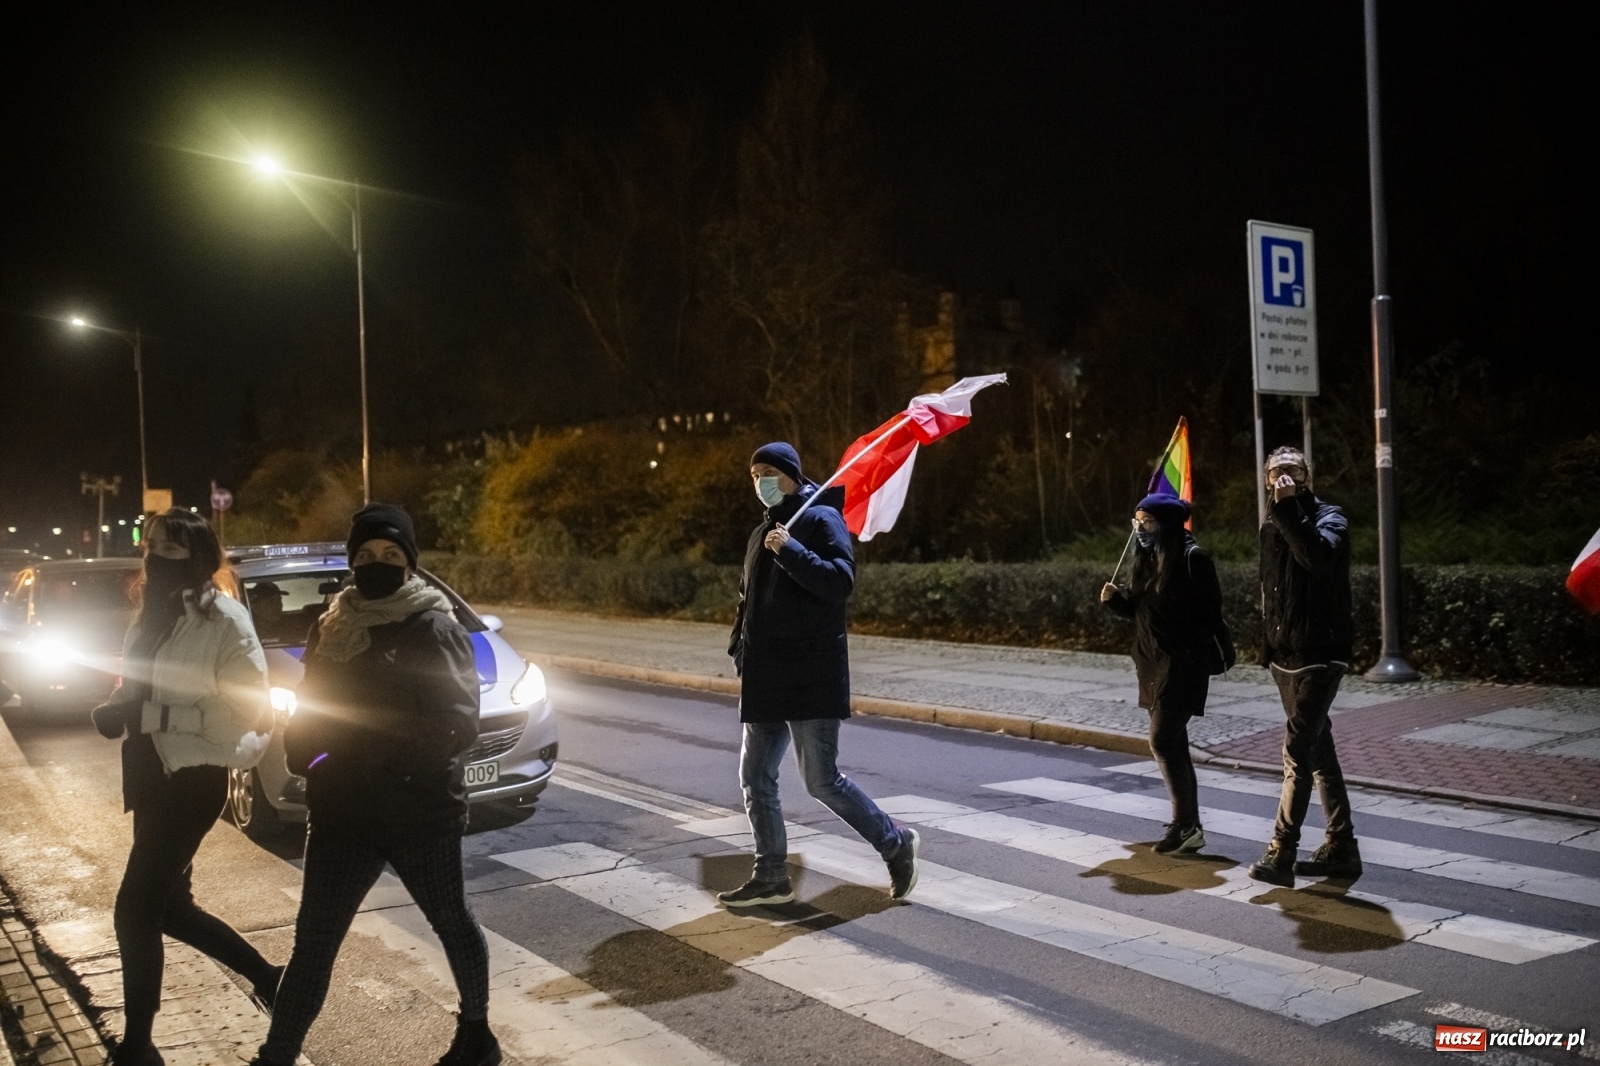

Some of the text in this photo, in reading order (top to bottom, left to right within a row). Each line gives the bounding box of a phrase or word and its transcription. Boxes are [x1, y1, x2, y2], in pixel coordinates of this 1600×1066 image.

[1271, 245, 1296, 297] P
[268, 546, 306, 555] POLICJA
[467, 765, 495, 783] 009
